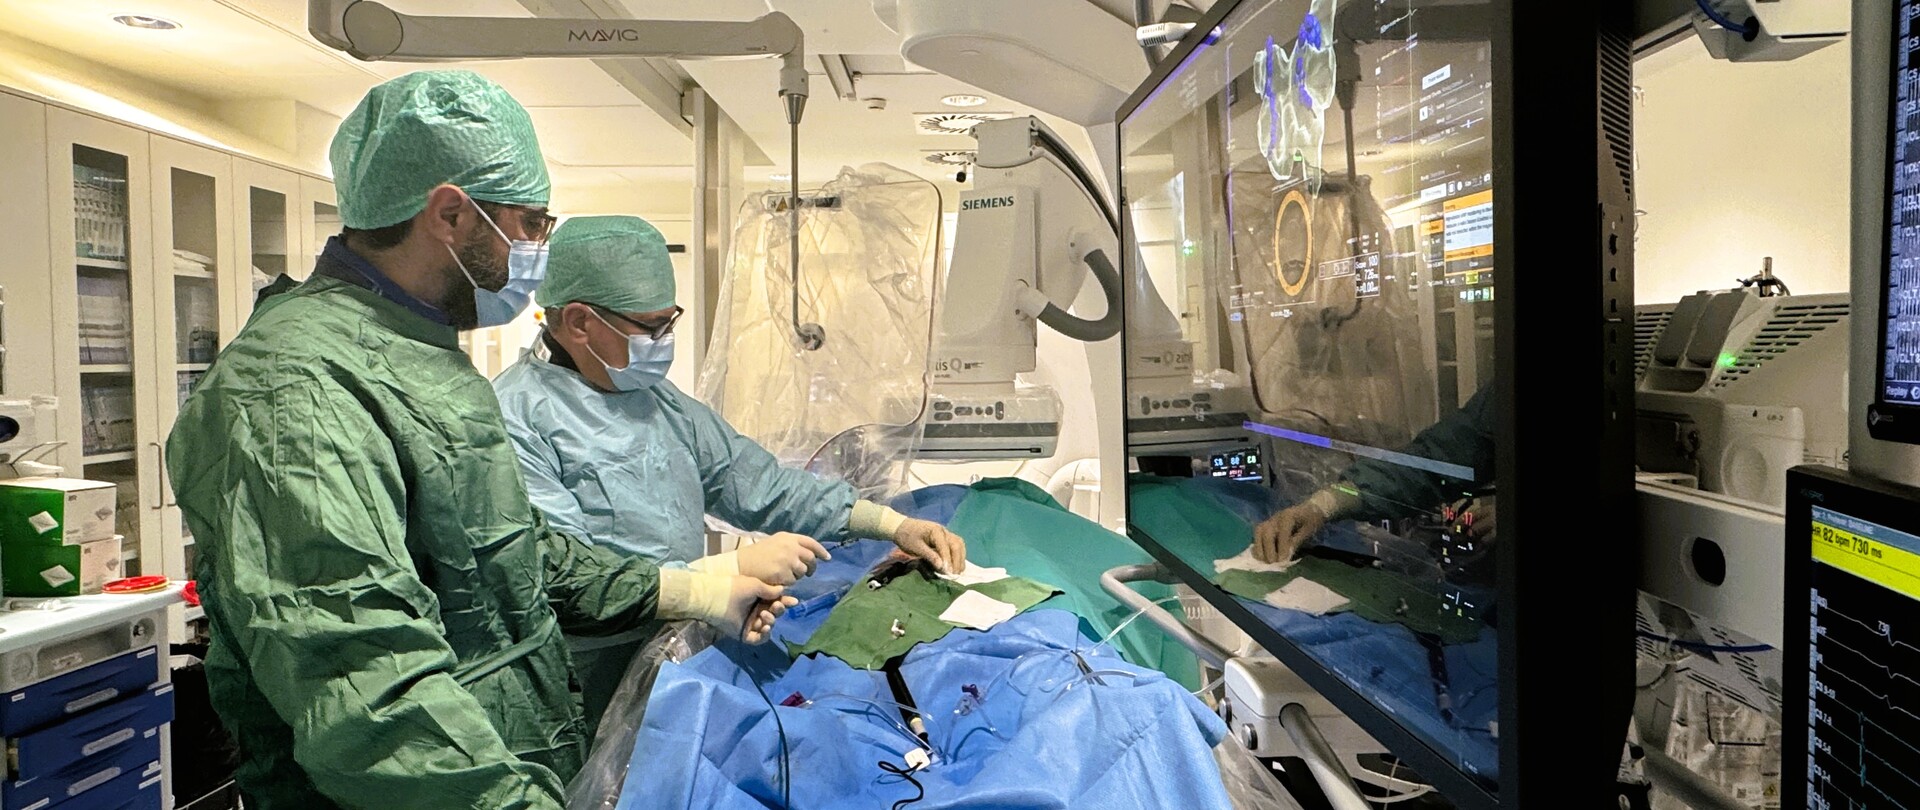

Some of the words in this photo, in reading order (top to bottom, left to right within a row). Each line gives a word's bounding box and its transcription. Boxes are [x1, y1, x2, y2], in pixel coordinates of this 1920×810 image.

[568, 29, 639, 42] MAVIG
[962, 195, 1015, 211] SIEMENS
[1886, 385, 1908, 399] Replay
[1823, 527, 1834, 544] 82
[1835, 534, 1850, 548] bpm
[1852, 537, 1868, 555] 730
[1871, 547, 1883, 559] ms
